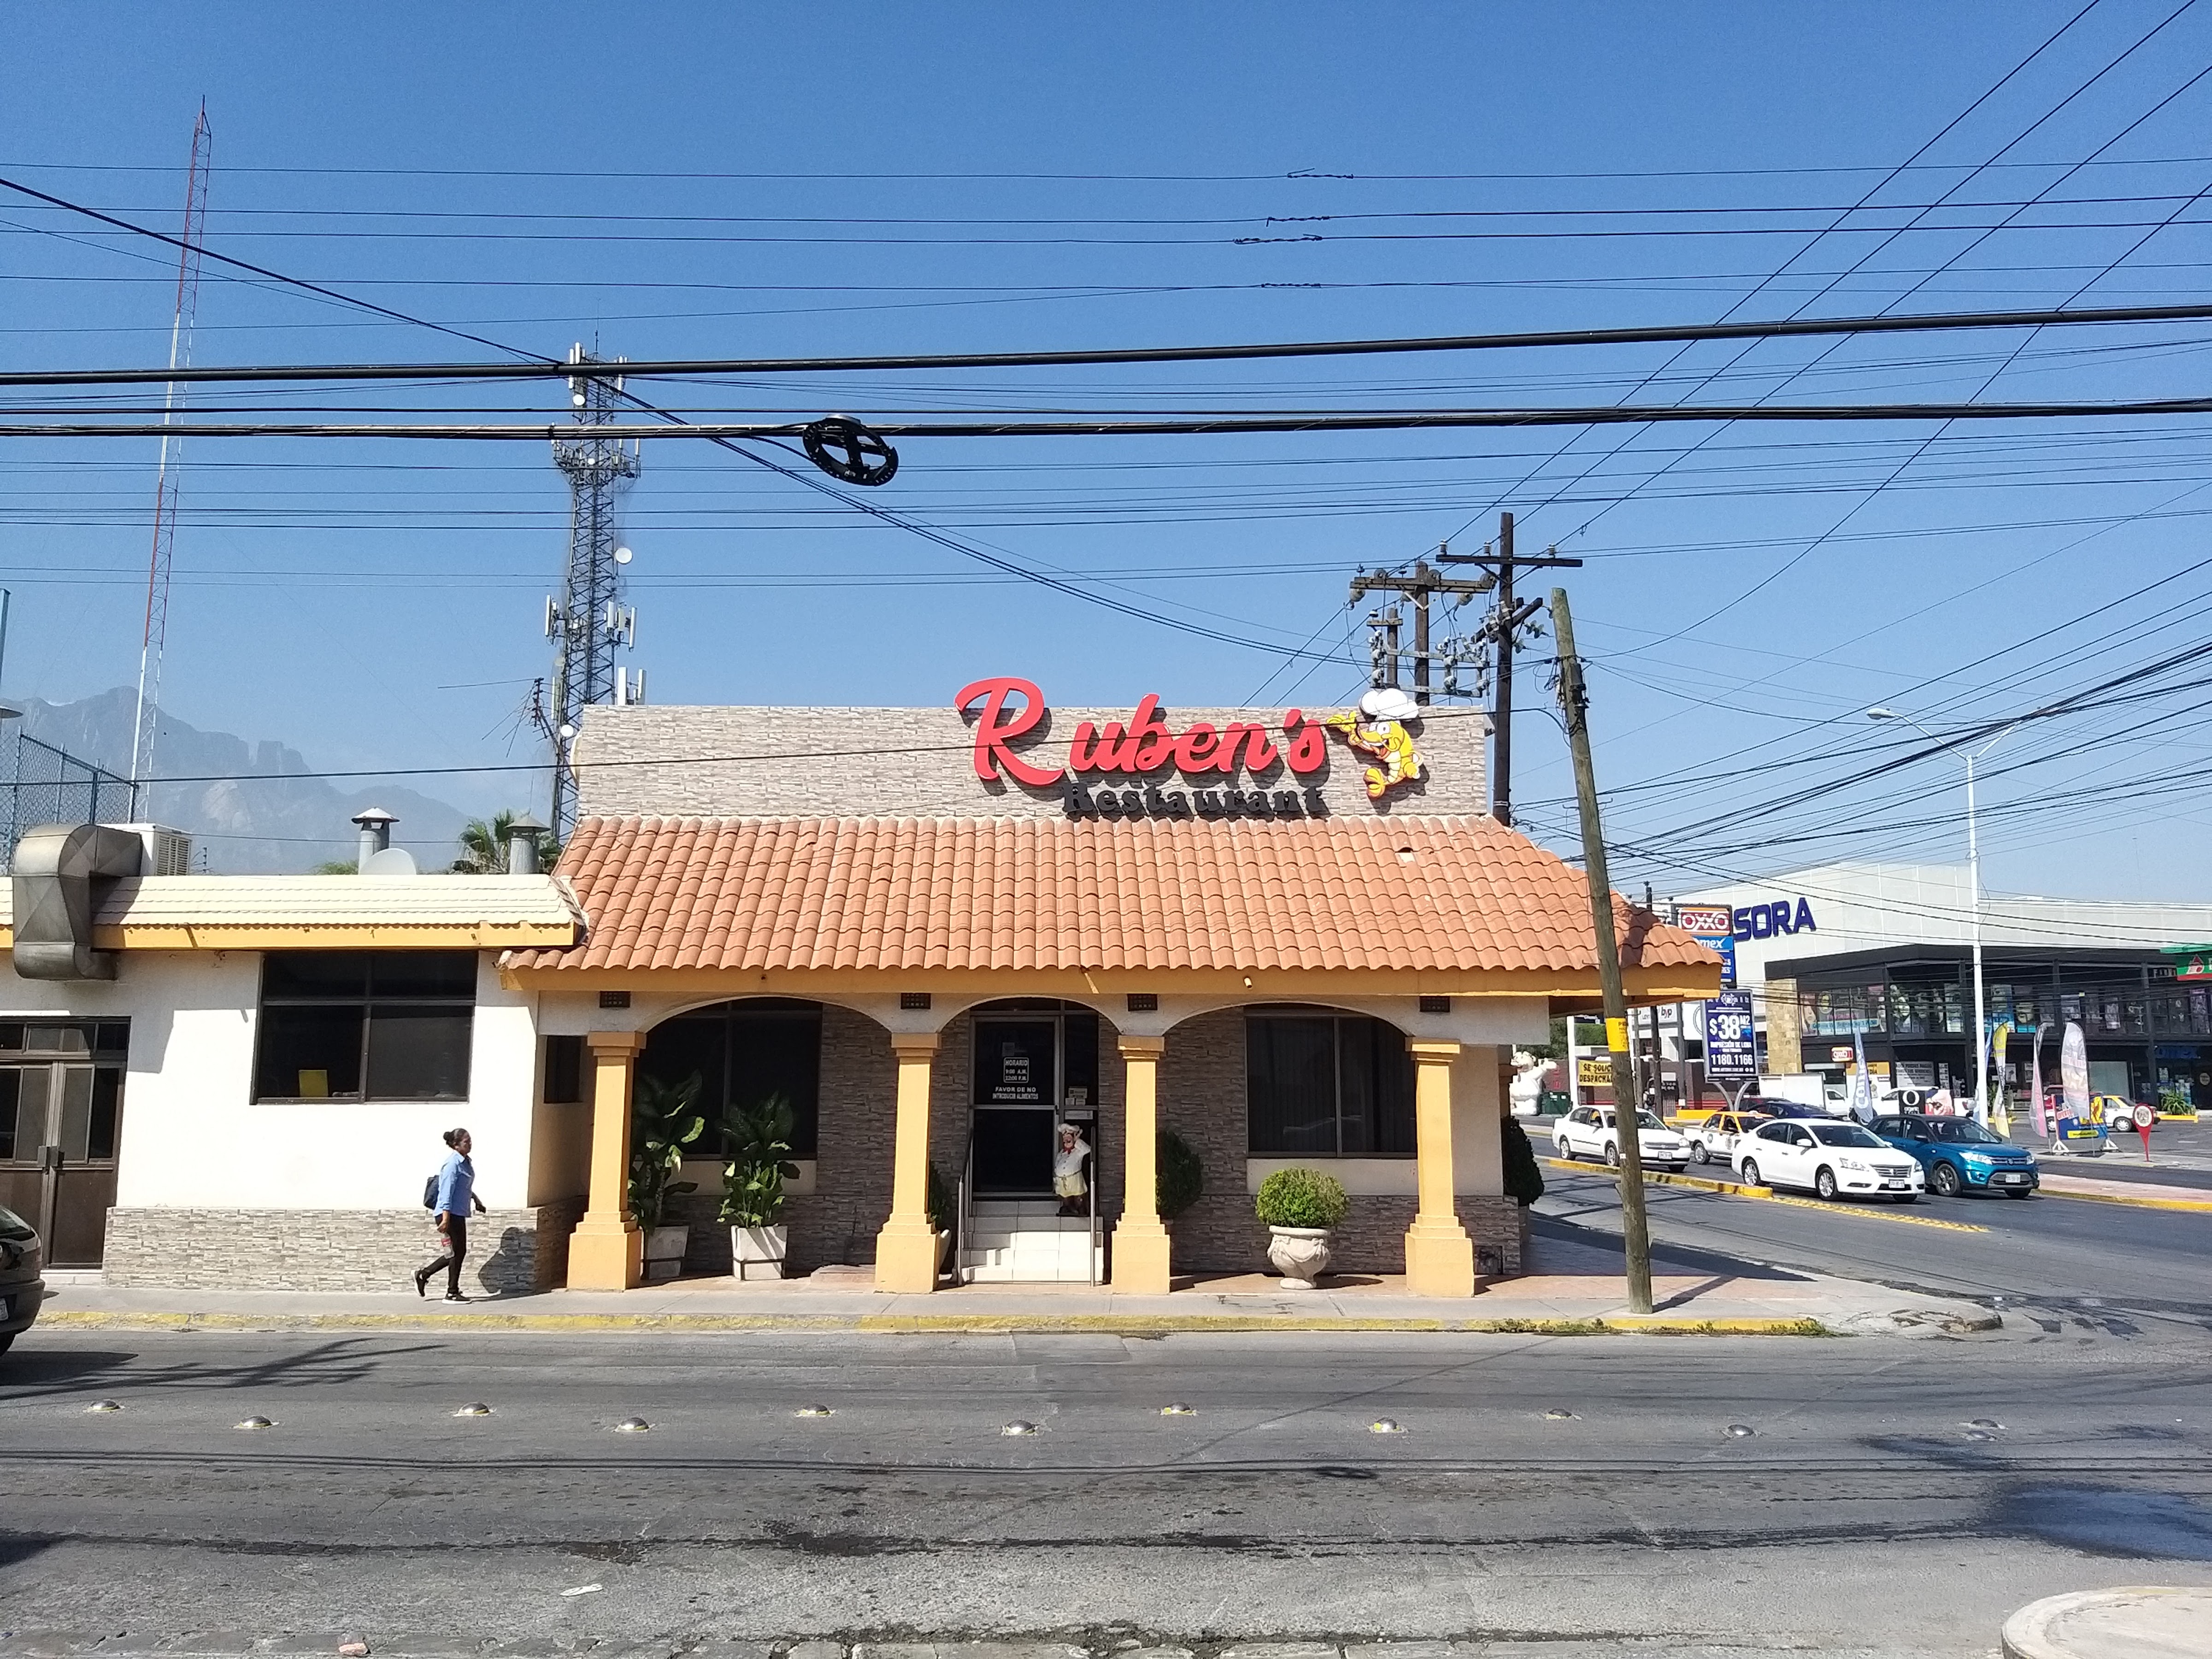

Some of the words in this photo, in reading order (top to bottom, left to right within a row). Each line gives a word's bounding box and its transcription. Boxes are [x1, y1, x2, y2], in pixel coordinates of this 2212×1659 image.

[954, 677, 1327, 786] Ruben's
[1063, 782, 1329, 818] Restaurant
[1682, 912, 1729, 930] OXXO
[1700, 937, 1726, 948] mex
[1709, 1014, 1741, 1040] $38
[1583, 1063, 1591, 1072] SE
[1594, 1064, 1612, 1073] SOLIC
[1711, 1054, 1753, 1065] 1180.1166
